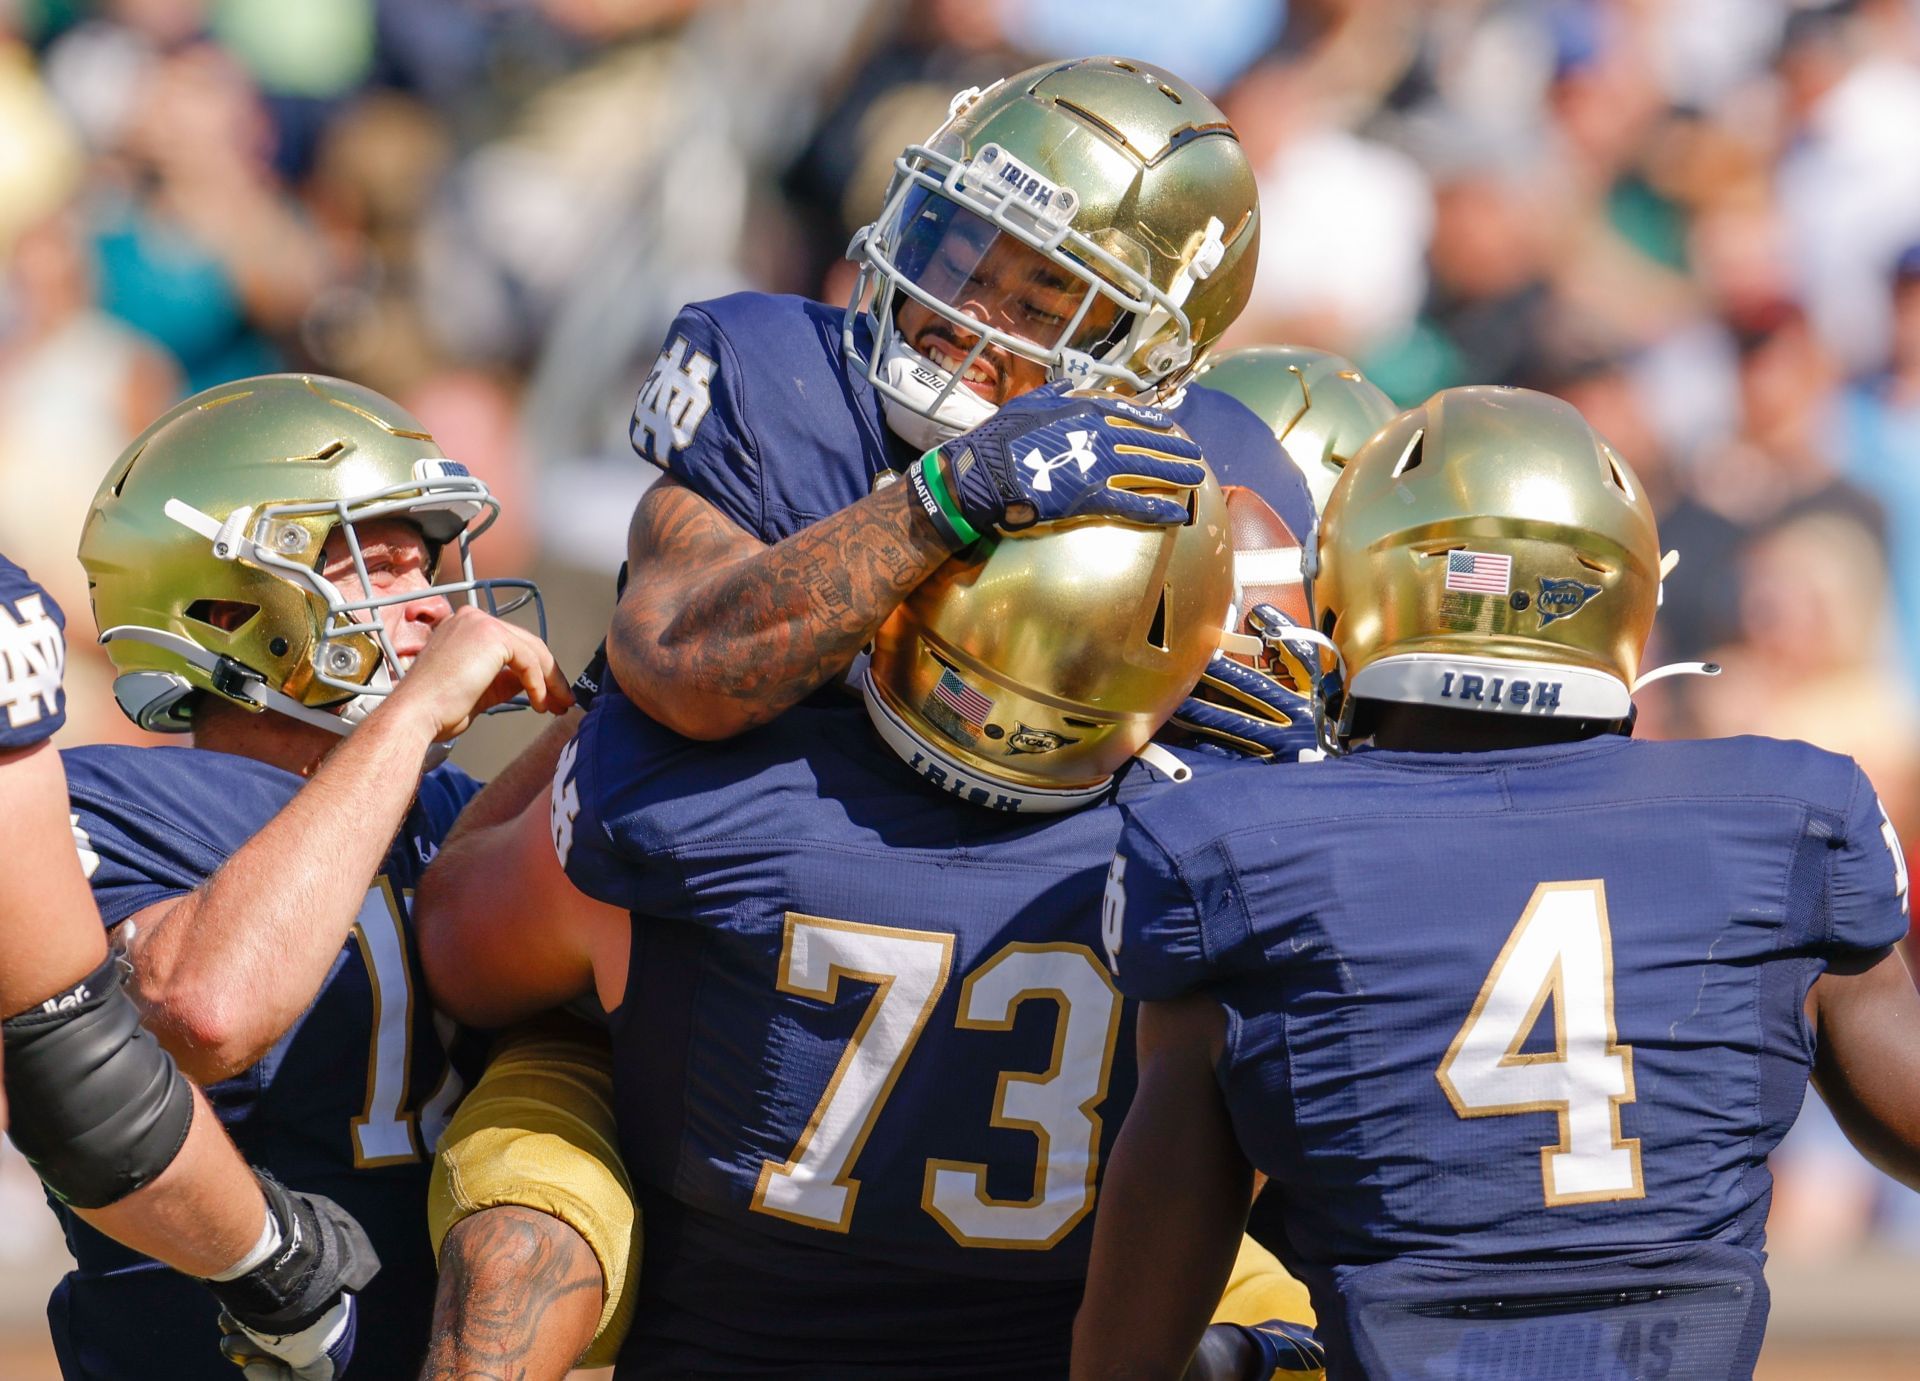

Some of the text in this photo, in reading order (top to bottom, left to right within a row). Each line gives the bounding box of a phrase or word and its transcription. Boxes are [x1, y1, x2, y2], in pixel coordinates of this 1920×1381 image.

[999, 161, 1054, 206] IRISH
[911, 367, 954, 394] schu
[913, 475, 938, 516] MATTER
[1441, 672, 1562, 707] IRISH
[909, 752, 1022, 813] IRISH
[1435, 879, 1645, 1207] 4
[749, 911, 1124, 1250] 73
